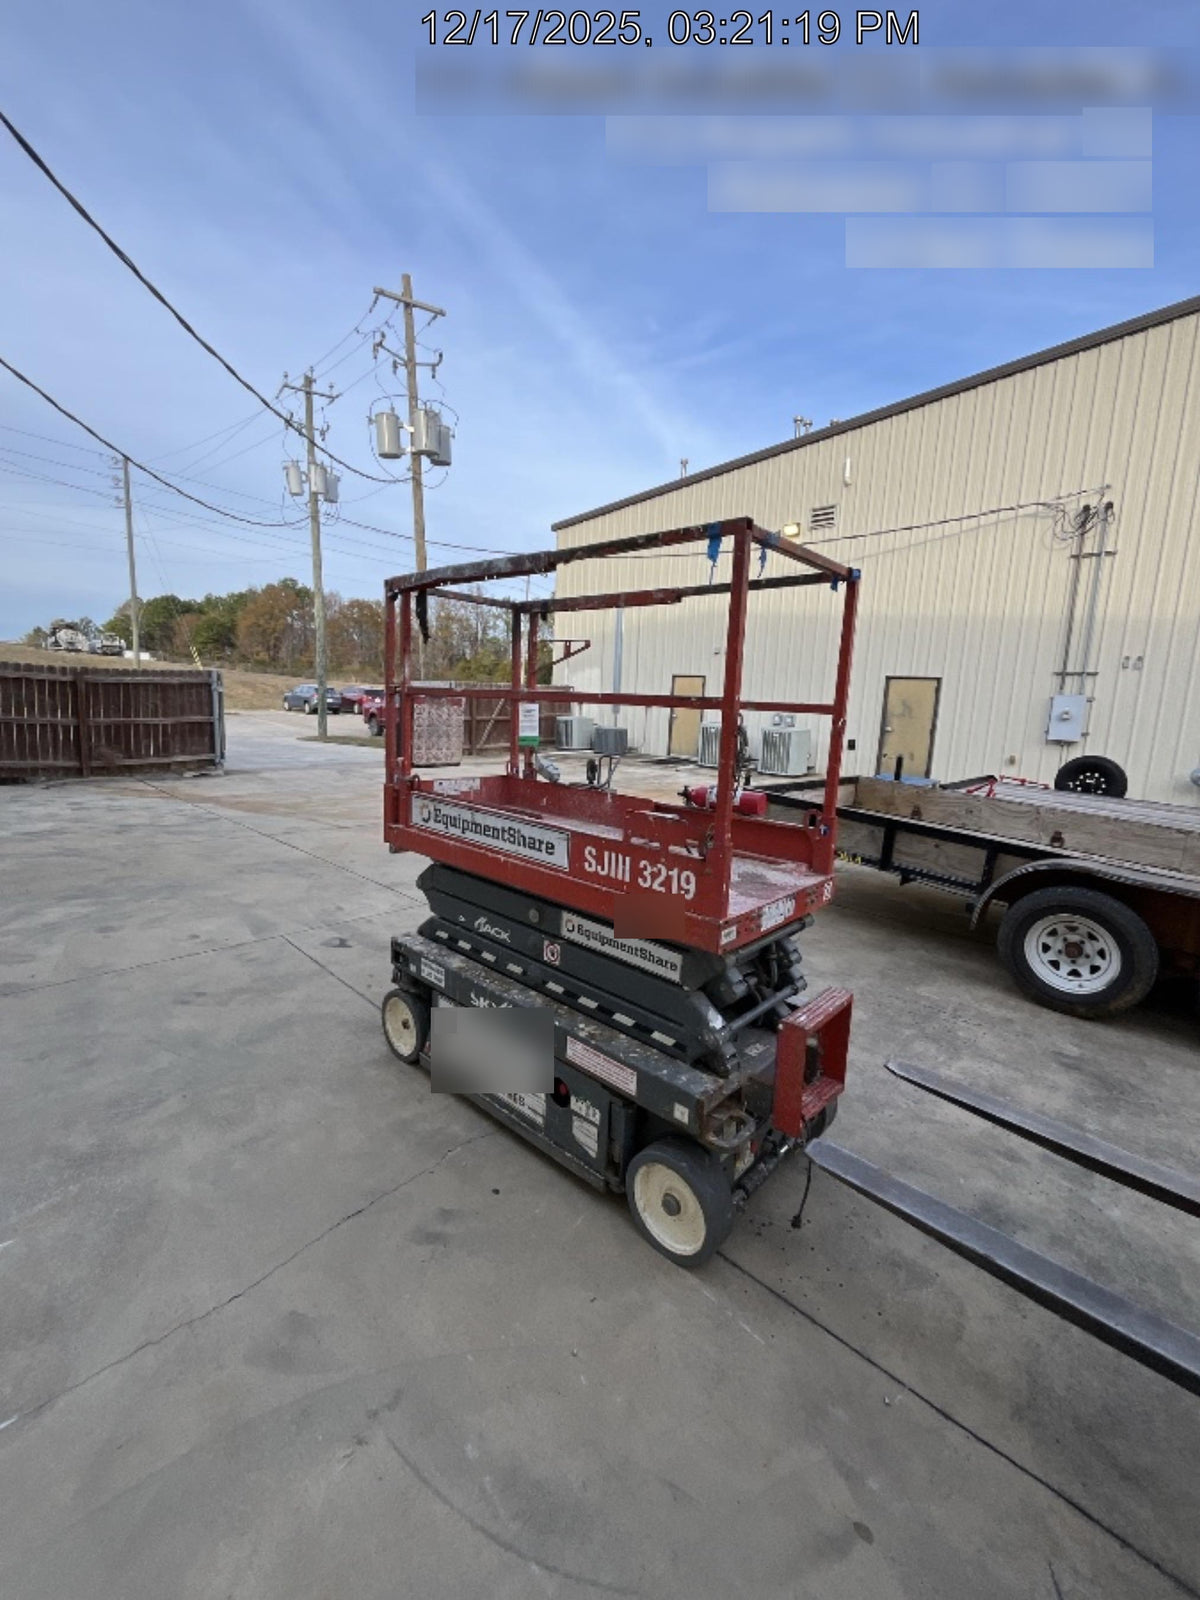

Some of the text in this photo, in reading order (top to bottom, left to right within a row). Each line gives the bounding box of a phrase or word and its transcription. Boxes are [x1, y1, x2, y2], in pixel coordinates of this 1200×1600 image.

[433, 804, 556, 855] EquipmentShare
[638, 861, 697, 900] 3219
[577, 923, 678, 973] EquipmentShare
